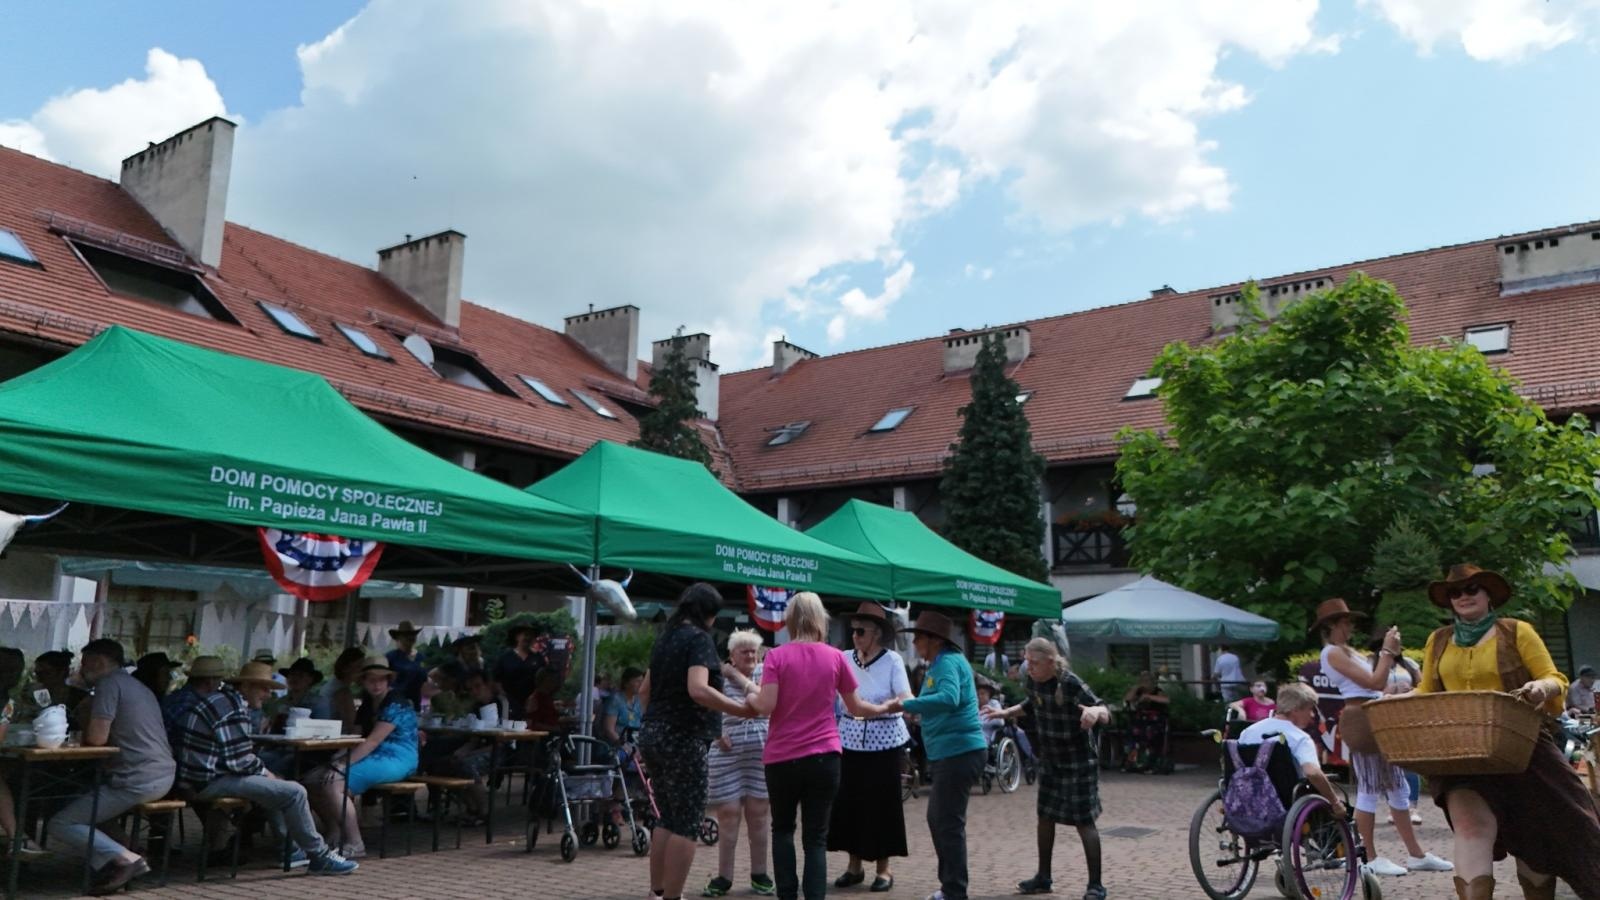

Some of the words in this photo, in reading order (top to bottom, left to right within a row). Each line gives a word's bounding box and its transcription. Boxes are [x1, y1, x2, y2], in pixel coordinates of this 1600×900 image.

[210, 466, 256, 488] DOM
[260, 474, 338, 500] POMOCY
[341, 488, 443, 516] SPOŁECZNEJ
[227, 491, 254, 511] im.
[260, 496, 325, 521] Papieża
[330, 507, 367, 526] Jana
[371, 512, 415, 532] Pawła
[418, 519, 427, 533] II
[715, 544, 735, 558] DOM
[736, 548, 771, 564] POMOCY
[767, 568, 785, 580] Jana
